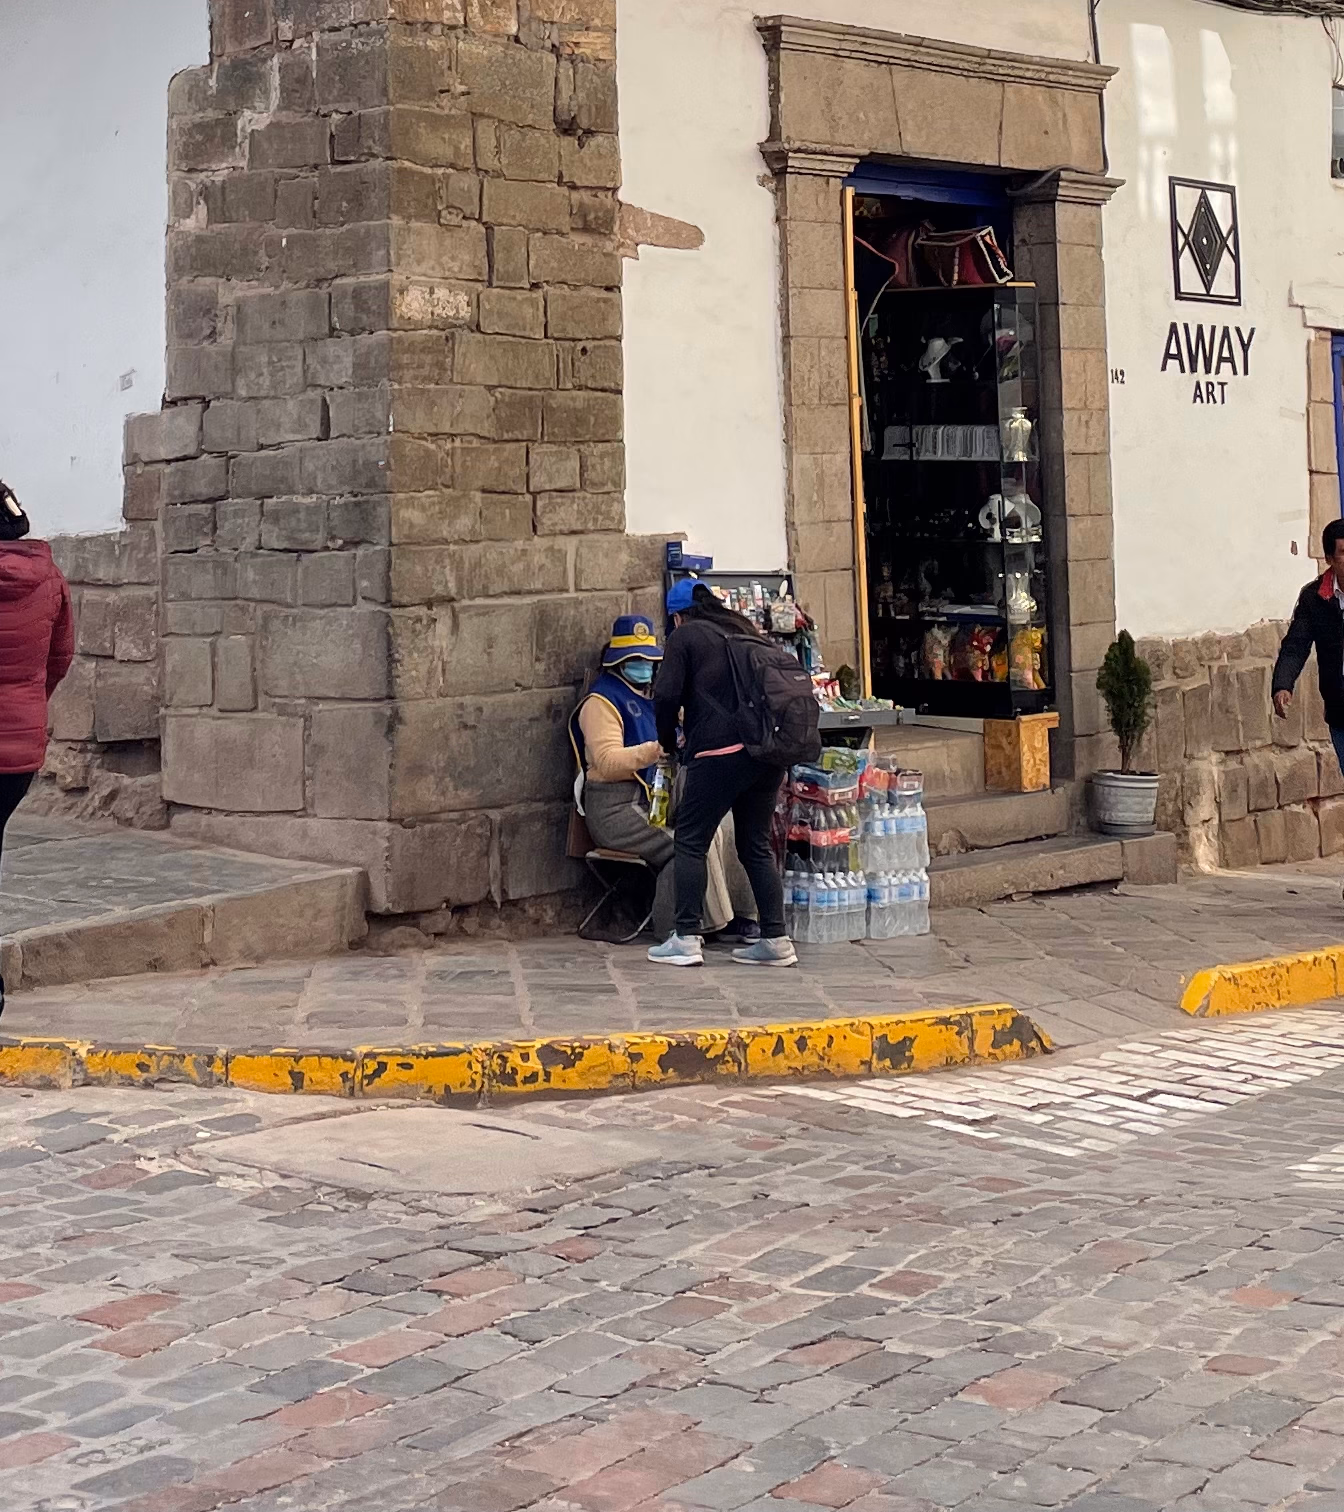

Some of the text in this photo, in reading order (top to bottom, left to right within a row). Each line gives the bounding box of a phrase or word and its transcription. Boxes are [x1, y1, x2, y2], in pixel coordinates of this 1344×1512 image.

[1160, 321, 1257, 377] AWAY
[1110, 368, 1126, 385] 142
[1192, 380, 1229, 405] ART
